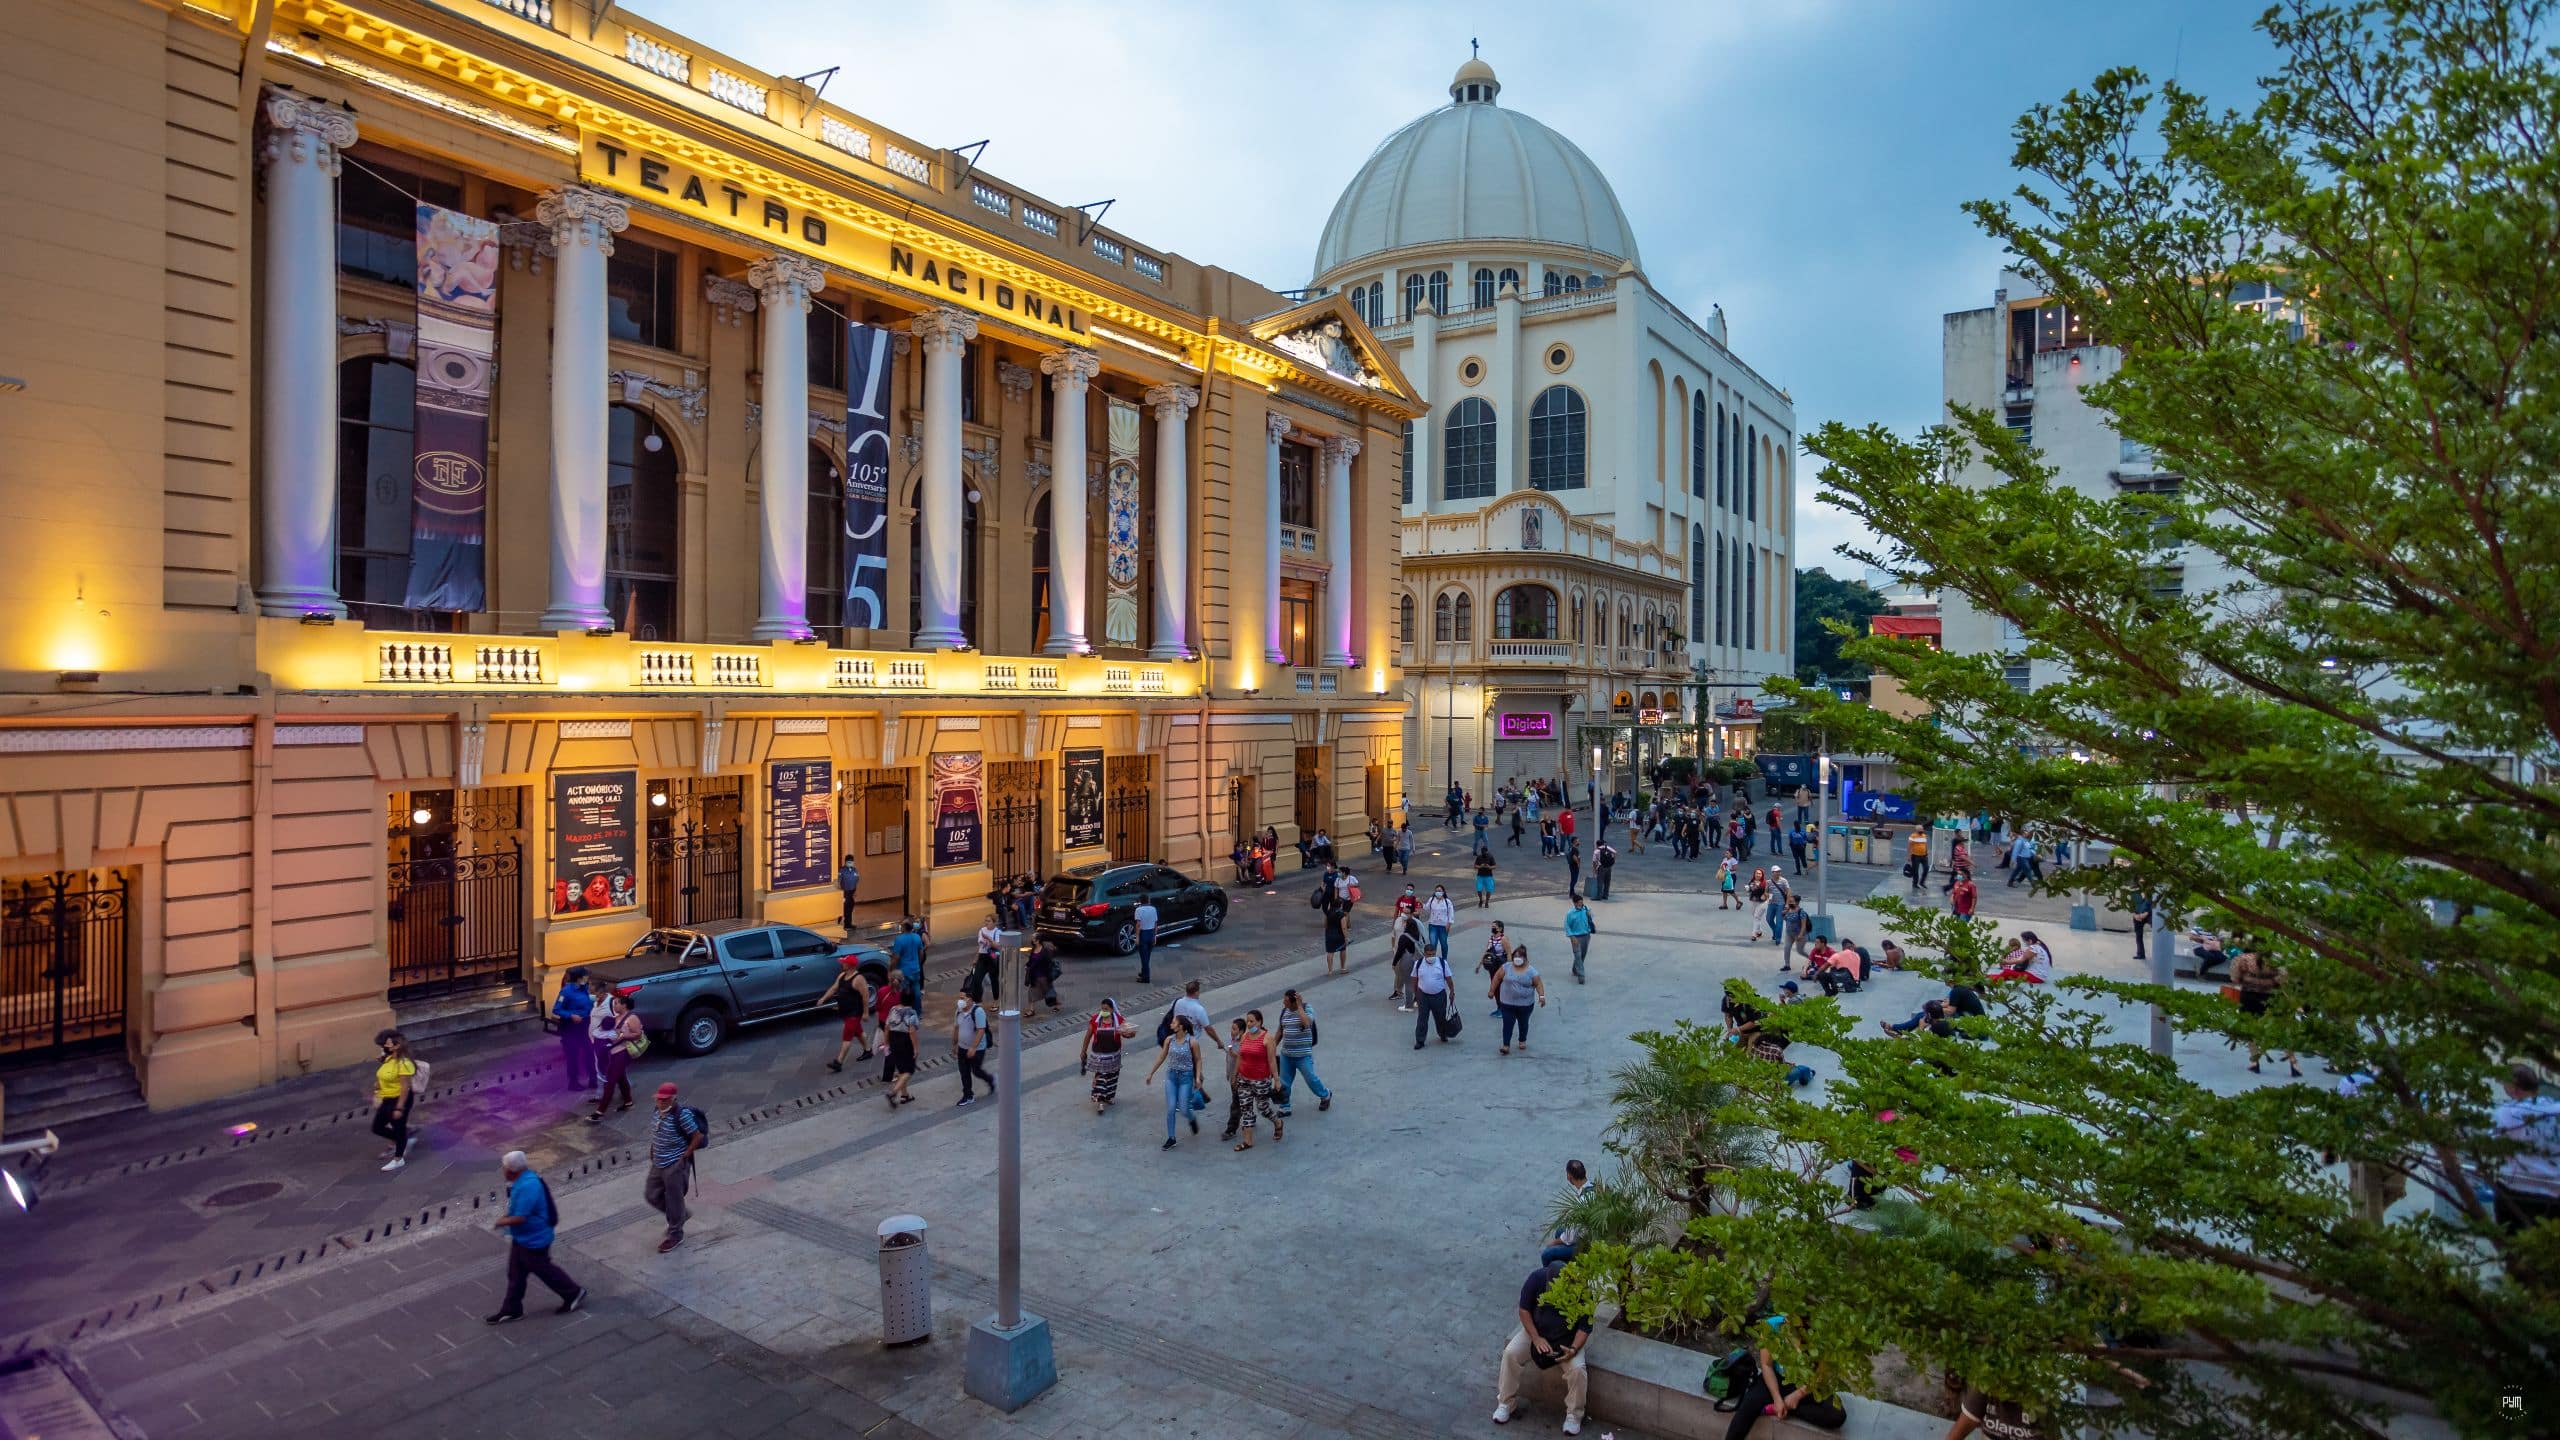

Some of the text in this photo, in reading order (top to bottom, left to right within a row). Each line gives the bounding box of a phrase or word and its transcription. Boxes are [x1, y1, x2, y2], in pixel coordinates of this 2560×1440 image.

[596, 139, 1086, 336] TEATRO NACIONAL
[846, 478, 887, 493] Aniversario
[1507, 717, 1547, 732] Digicel
